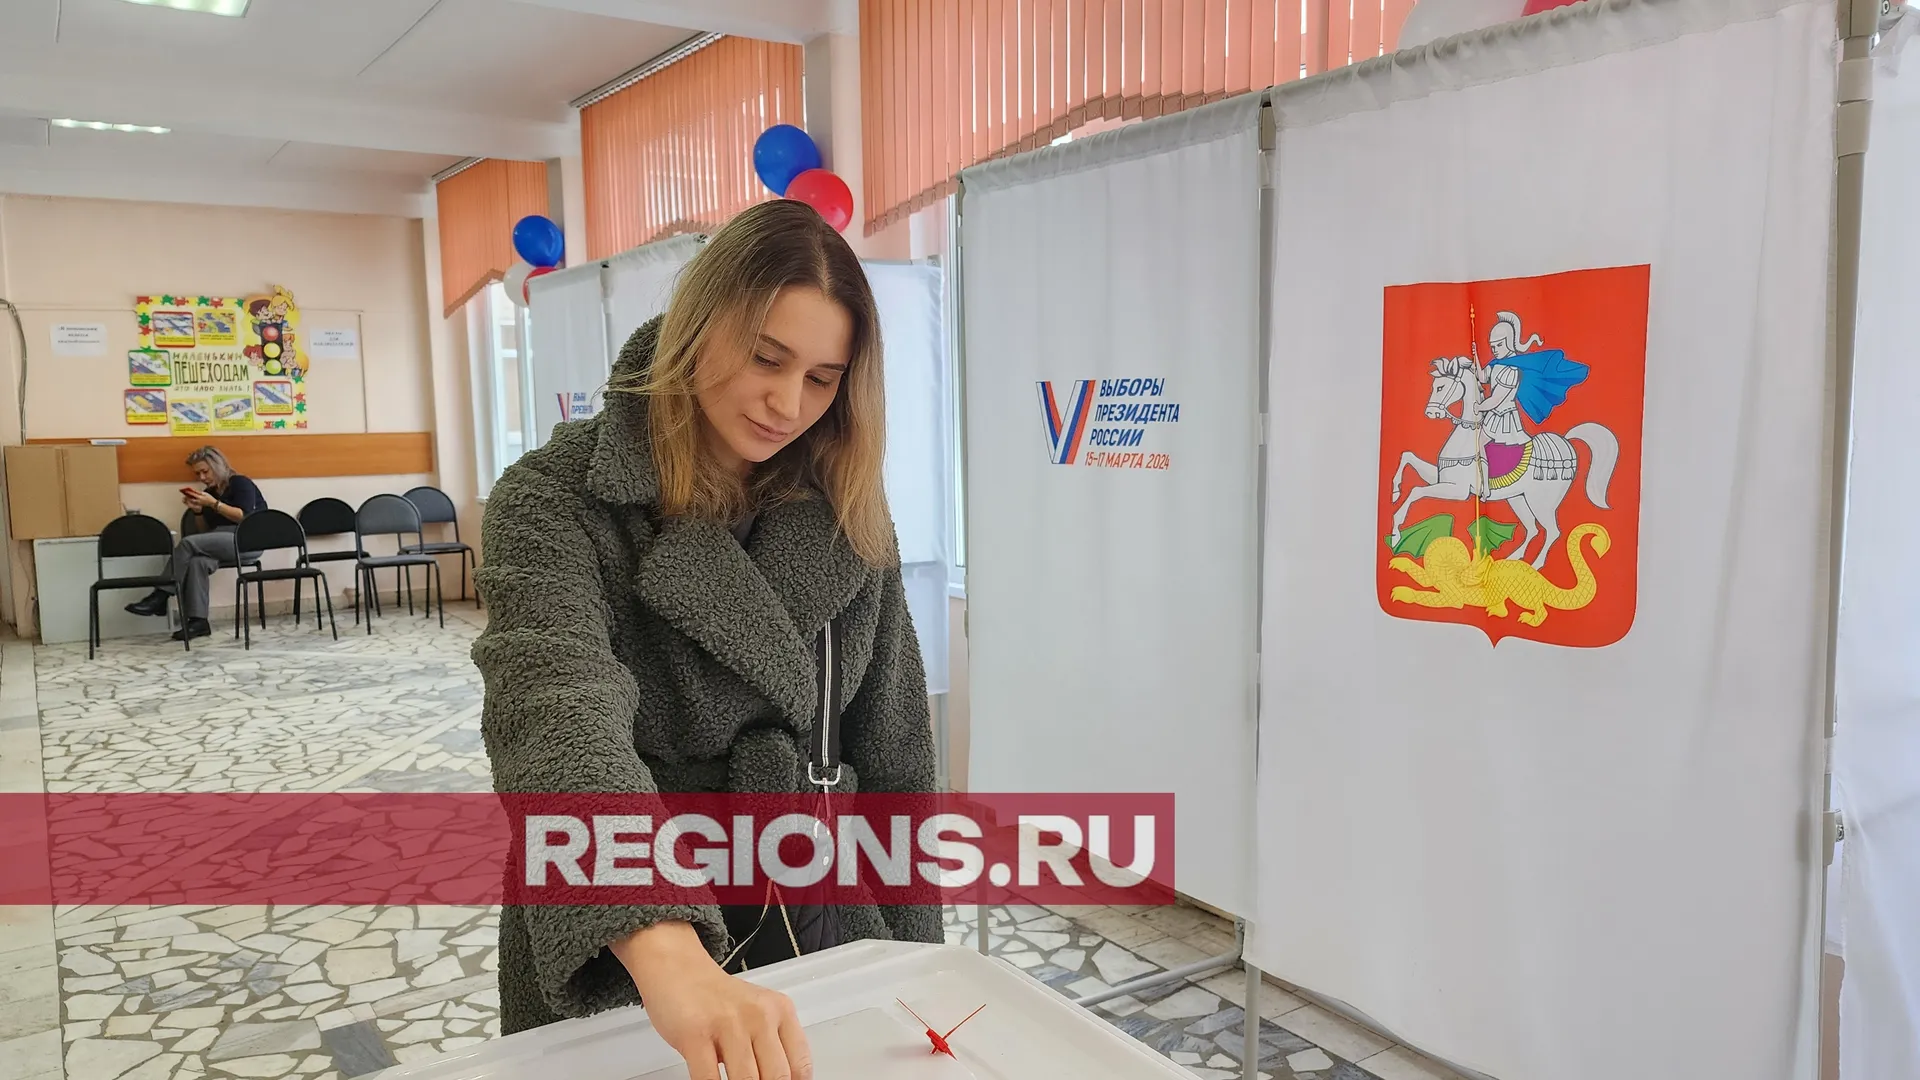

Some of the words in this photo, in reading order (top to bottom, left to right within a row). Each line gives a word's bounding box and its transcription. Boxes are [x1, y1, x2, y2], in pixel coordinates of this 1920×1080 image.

[174, 361, 249, 385] ПЕШЕХОДАМ
[1099, 377, 1165, 397] ВЫБОРЫ
[1094, 403, 1180, 424] ПРЕЗИДЕНТА
[1088, 428, 1145, 447] РОССИИ
[1105, 452, 1145, 469] МАРТА
[1145, 453, 1171, 471] 2024
